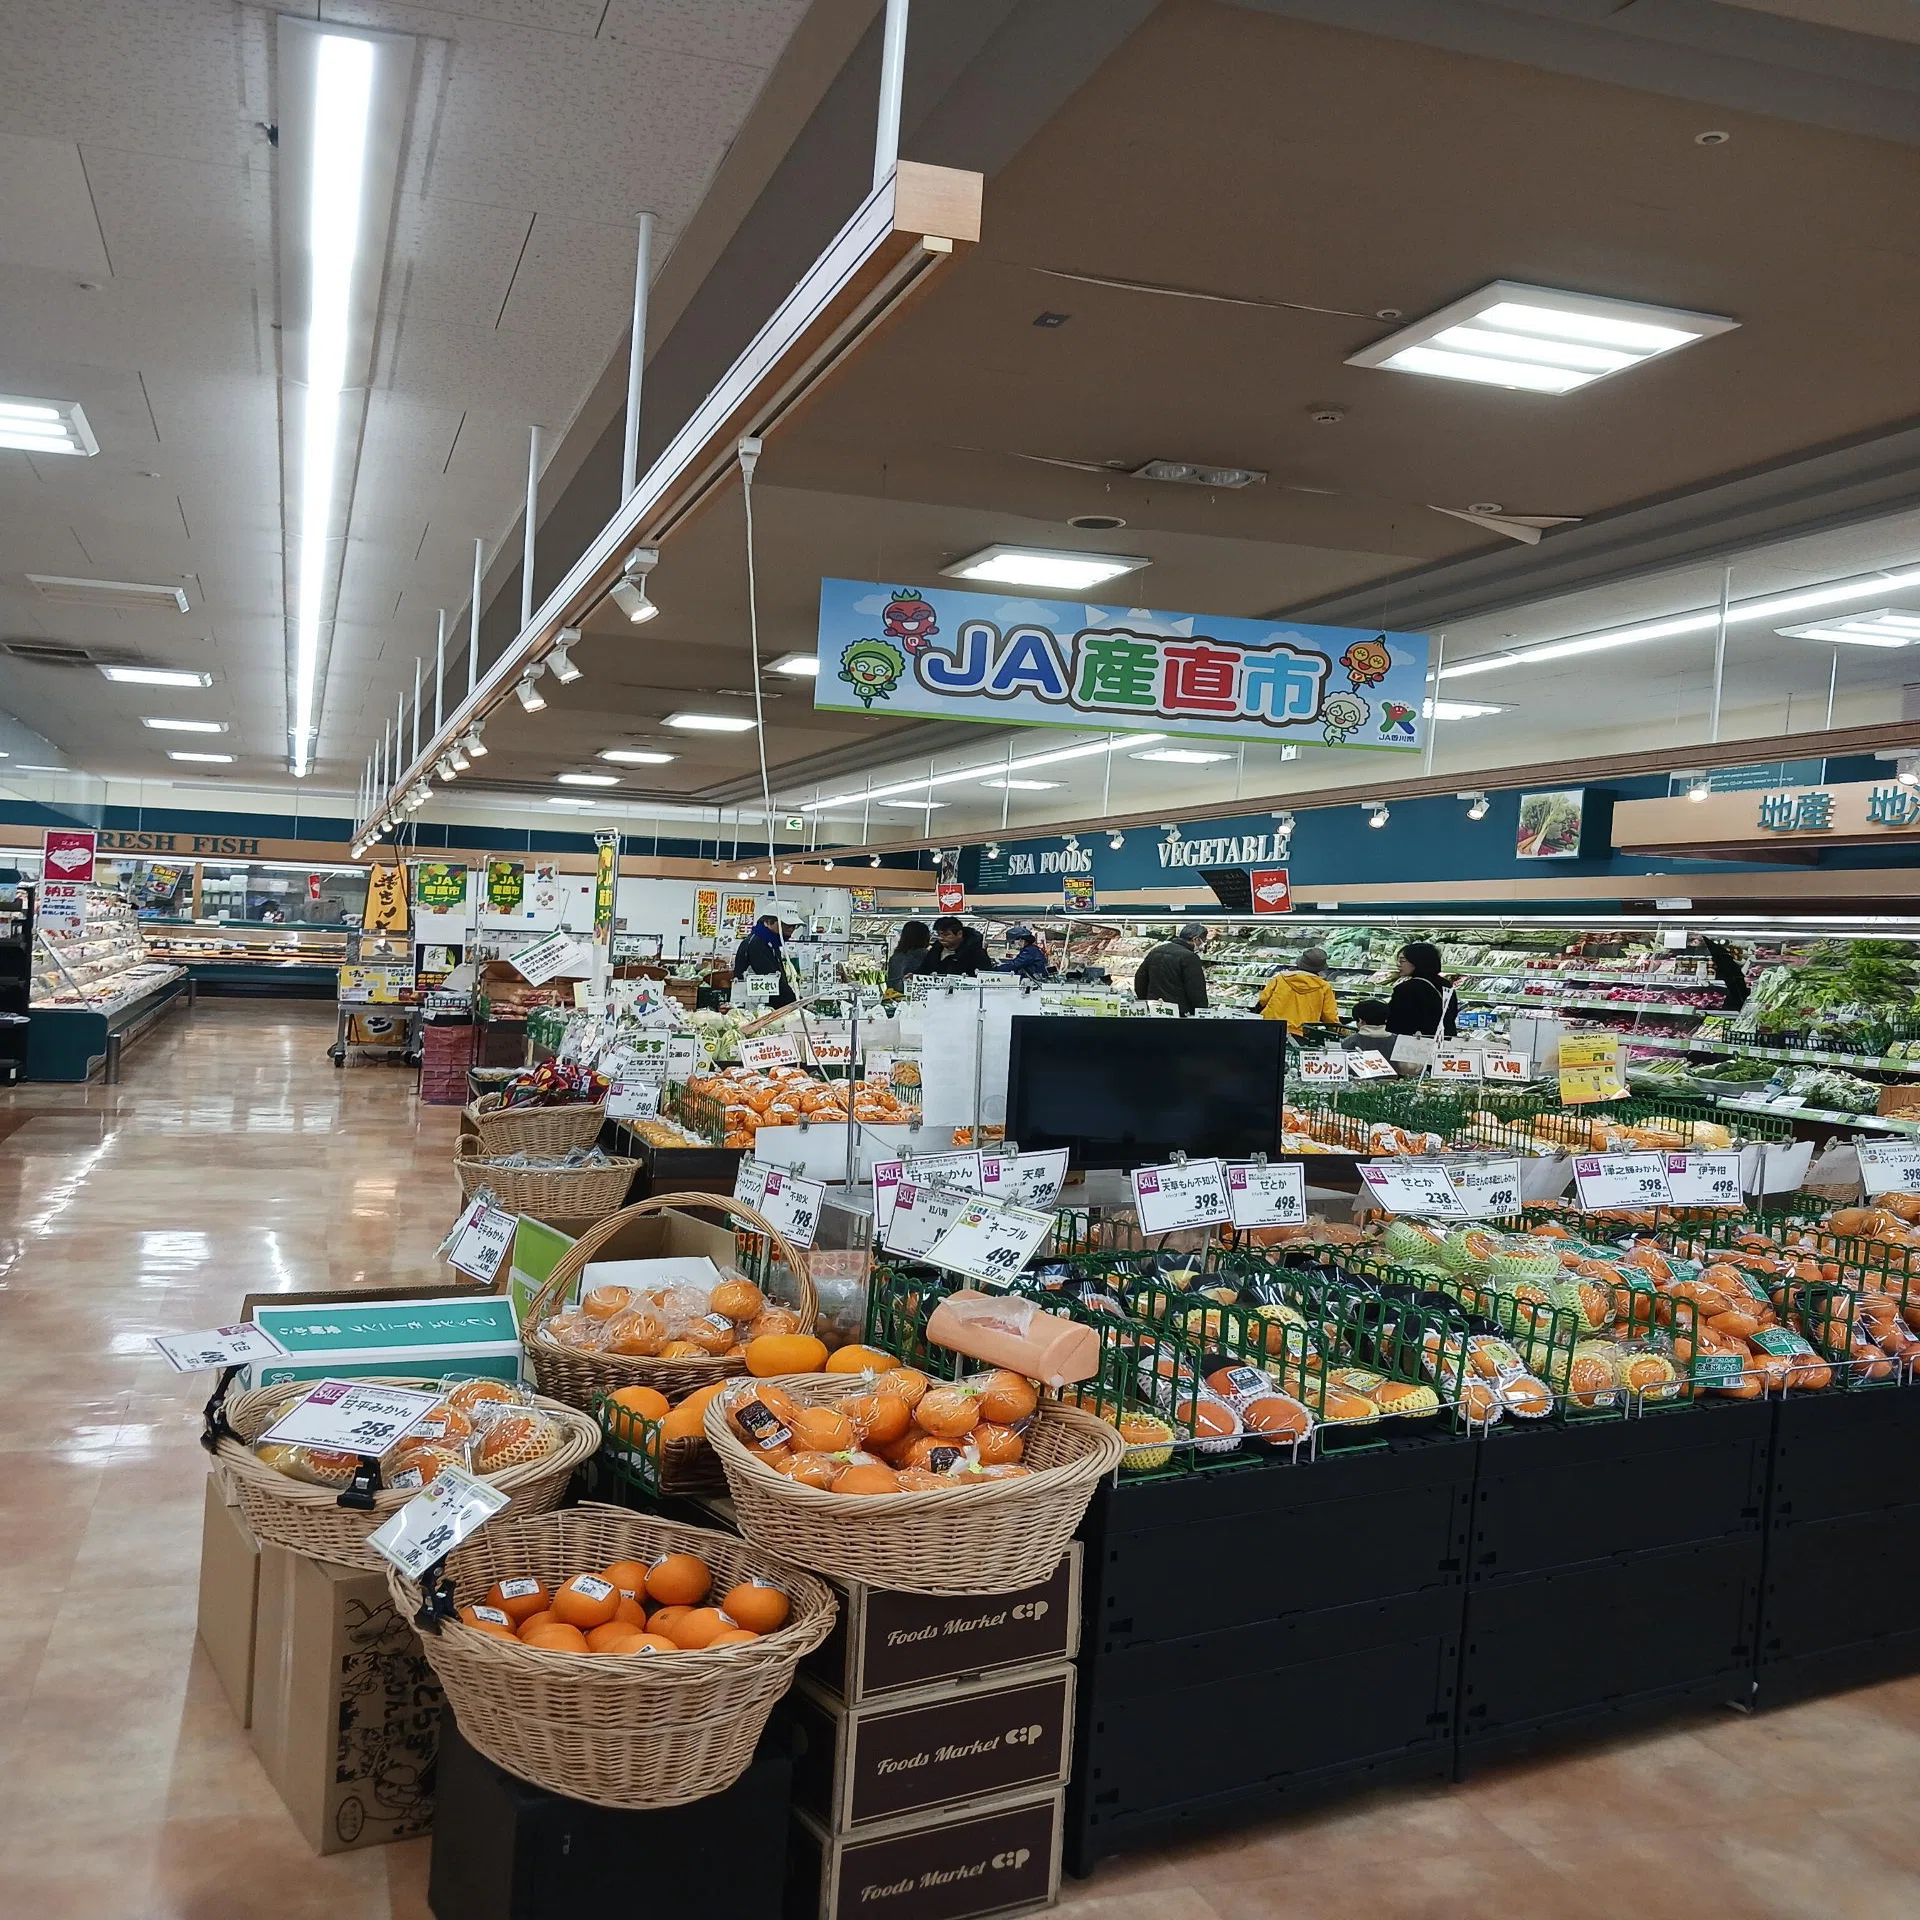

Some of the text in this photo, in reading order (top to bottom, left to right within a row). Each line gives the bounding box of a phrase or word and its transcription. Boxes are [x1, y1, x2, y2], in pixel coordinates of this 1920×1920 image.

[924, 627, 1323, 723] JA産直市
[1757, 791, 1834, 832] 地産
[97, 831, 260, 856] RESH FISH
[1157, 833, 1291, 868] VEGETABLE
[1007, 853, 1036, 876] SEA
[1039, 848, 1092, 874] FOODS
[432, 876, 453, 886] JA
[499, 876, 515, 886] JA
[751, 981, 777, 991] はくさい
[814, 1045, 858, 1058] みかん
[1305, 1061, 1344, 1075] ポンカン
[1353, 1058, 1389, 1072] いちご
[1441, 1060, 1472, 1073] 文旦
[1578, 1161, 1600, 1173] SALE
[1603, 1165, 1661, 1176] 津之輝みかん
[1669, 1159, 1686, 1170] SALE
[1698, 1165, 1727, 1176] 伊予柑
[879, 1168, 901, 1181] SALE
[983, 1165, 999, 1178] ALE
[1022, 1167, 1046, 1181] 天草
[1138, 1176, 1159, 1189] SALE
[1162, 1174, 1219, 1192] 天草もん不知火
[1230, 1173, 1246, 1185] SALE
[1260, 1179, 1287, 1190] せとか
[1401, 1177, 1435, 1188] せとか
[898, 1188, 916, 1203] SALE
[988, 1221, 1028, 1241] ネーブル
[314, 1388, 345, 1400] SALE
[340, 1399, 412, 1418] 甘平みかん
[887, 1620, 937, 1647] Foods
[943, 1610, 1007, 1635] Market
[877, 1749, 928, 1776] Foods
[934, 1736, 1000, 1763] Market
[860, 1875, 913, 1903] Foods
[919, 1861, 986, 1889] Market
